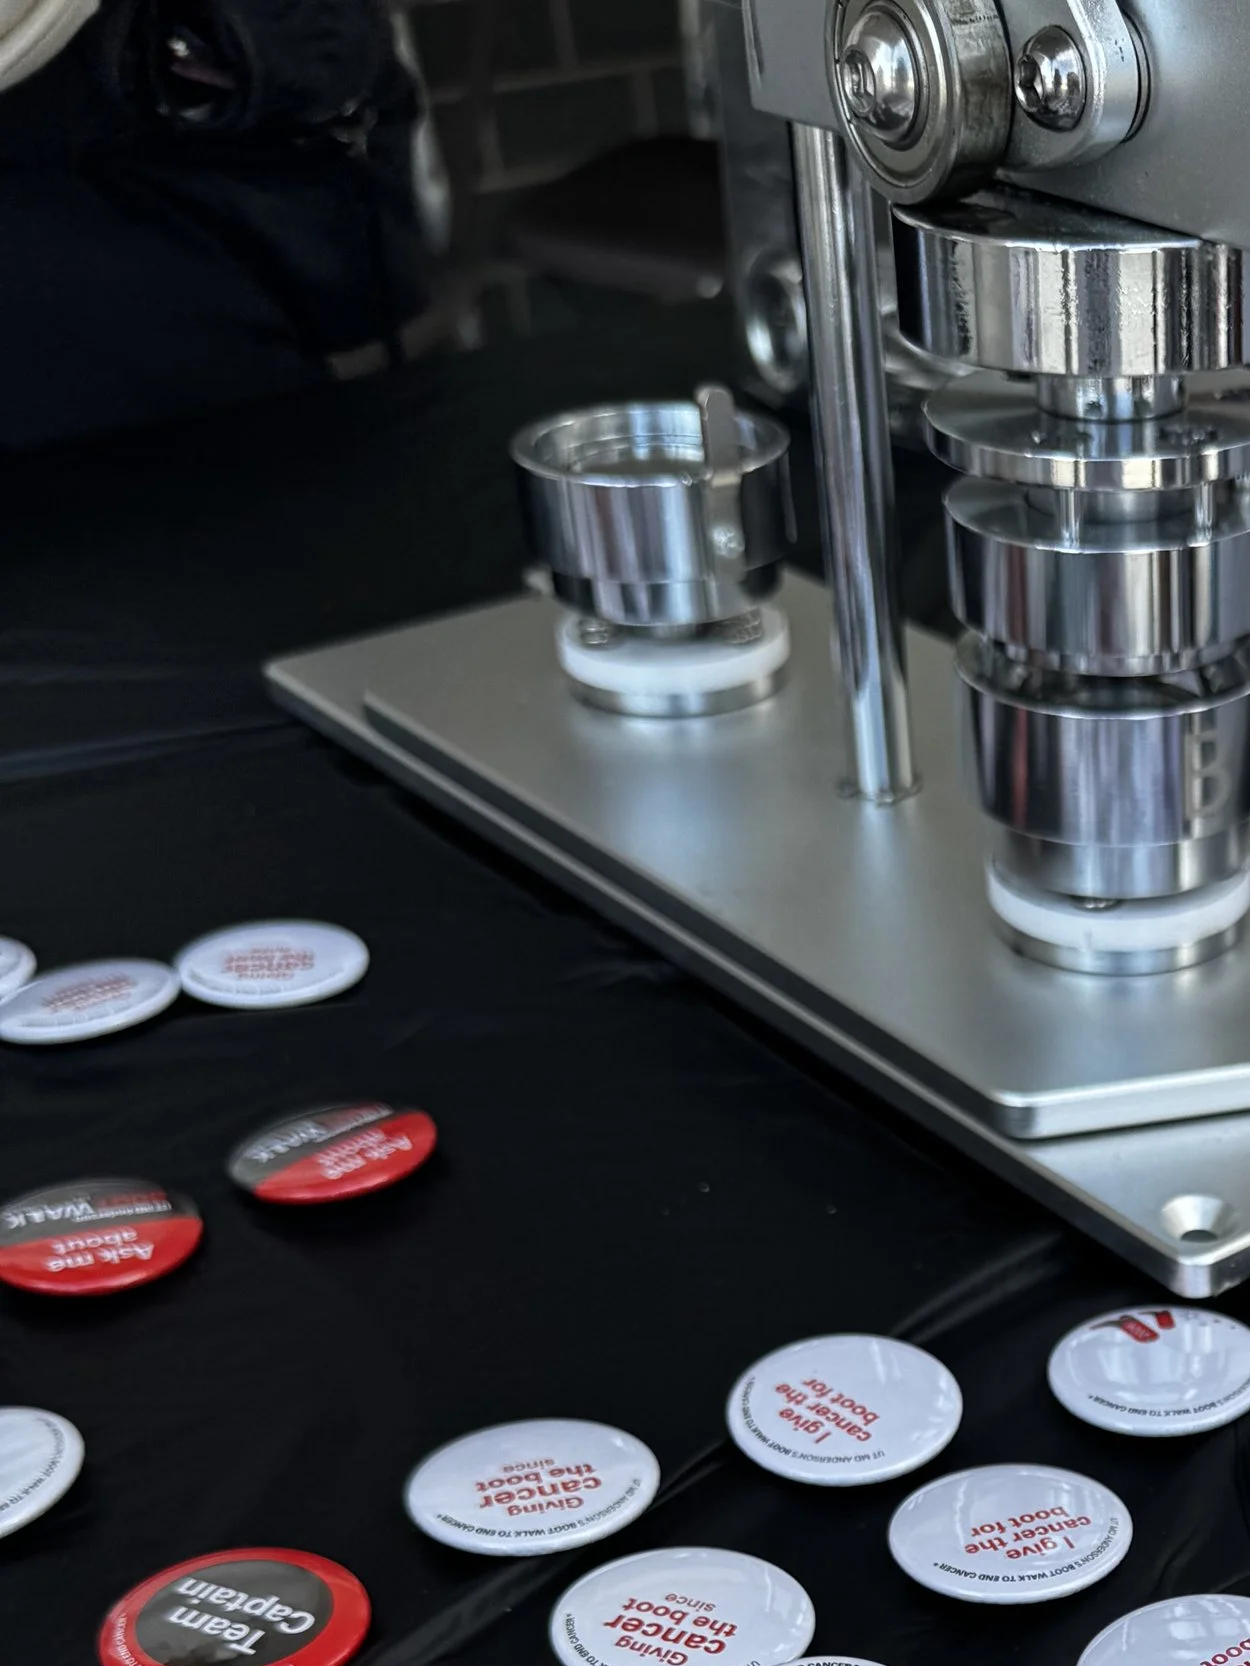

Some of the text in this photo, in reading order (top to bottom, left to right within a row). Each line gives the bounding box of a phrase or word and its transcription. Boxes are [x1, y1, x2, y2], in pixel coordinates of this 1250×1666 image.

[774, 1382, 872, 1442] cancer the
[802, 1378, 880, 1426] boot for
[778, 1407, 832, 1444] I give
[475, 1463, 598, 1492] the boot
[502, 1459, 555, 1473] since
[479, 1476, 602, 1509] cancer
[508, 1496, 584, 1517] Giving
[965, 1515, 1091, 1554] cancer the
[971, 1506, 1070, 1537] boot for
[1006, 1536, 1075, 1560] I give
[175, 1577, 315, 1635] Captain
[622, 1598, 737, 1638] the boot
[665, 1593, 716, 1612] since
[168, 1606, 266, 1657] Team
[603, 1613, 726, 1654] cancer
[615, 1635, 689, 1666] Giving
